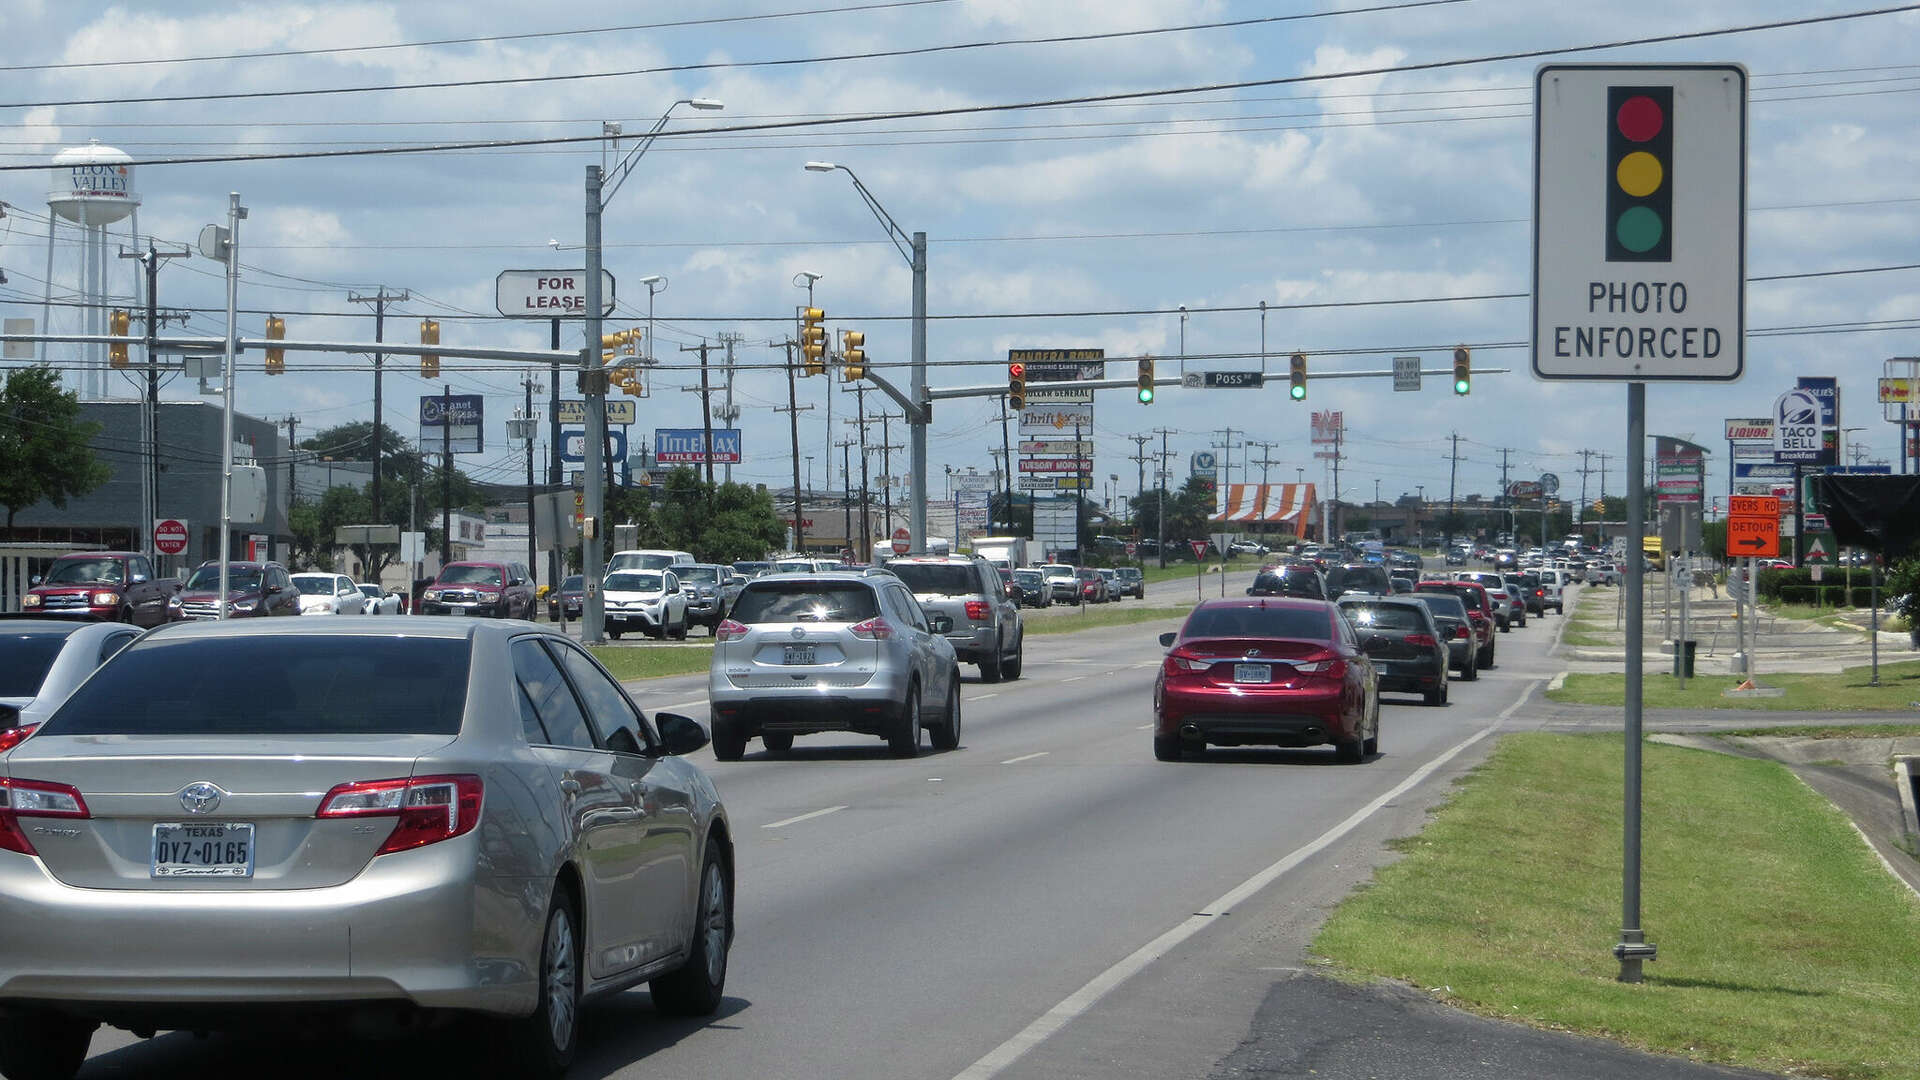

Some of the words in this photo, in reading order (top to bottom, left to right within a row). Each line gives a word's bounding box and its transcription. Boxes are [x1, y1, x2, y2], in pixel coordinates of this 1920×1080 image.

[72, 165, 115, 176] LEON
[72, 176, 128, 190] VALLEY
[537, 277, 575, 290] FOR
[526, 296, 585, 309] LEASE
[1589, 282, 1688, 314] PHOTO
[1554, 326, 1722, 359] ENFORCED
[1055, 388, 1089, 398] GENERAL
[440, 401, 471, 411] Panet
[560, 403, 627, 413] BANRA
[1727, 427, 1769, 438] LIQUOR
[1780, 427, 1816, 438] TACO
[1782, 438, 1816, 448] BELL
[1780, 452, 1816, 460] Breakfast
[1020, 461, 1053, 470] TUESDAY
[1056, 461, 1091, 470] MORNNG
[1731, 500, 1758, 511] EVERS
[1764, 501, 1777, 511] RD
[1732, 522, 1774, 532] DETOUR
[185, 828, 224, 838] TEXAS
